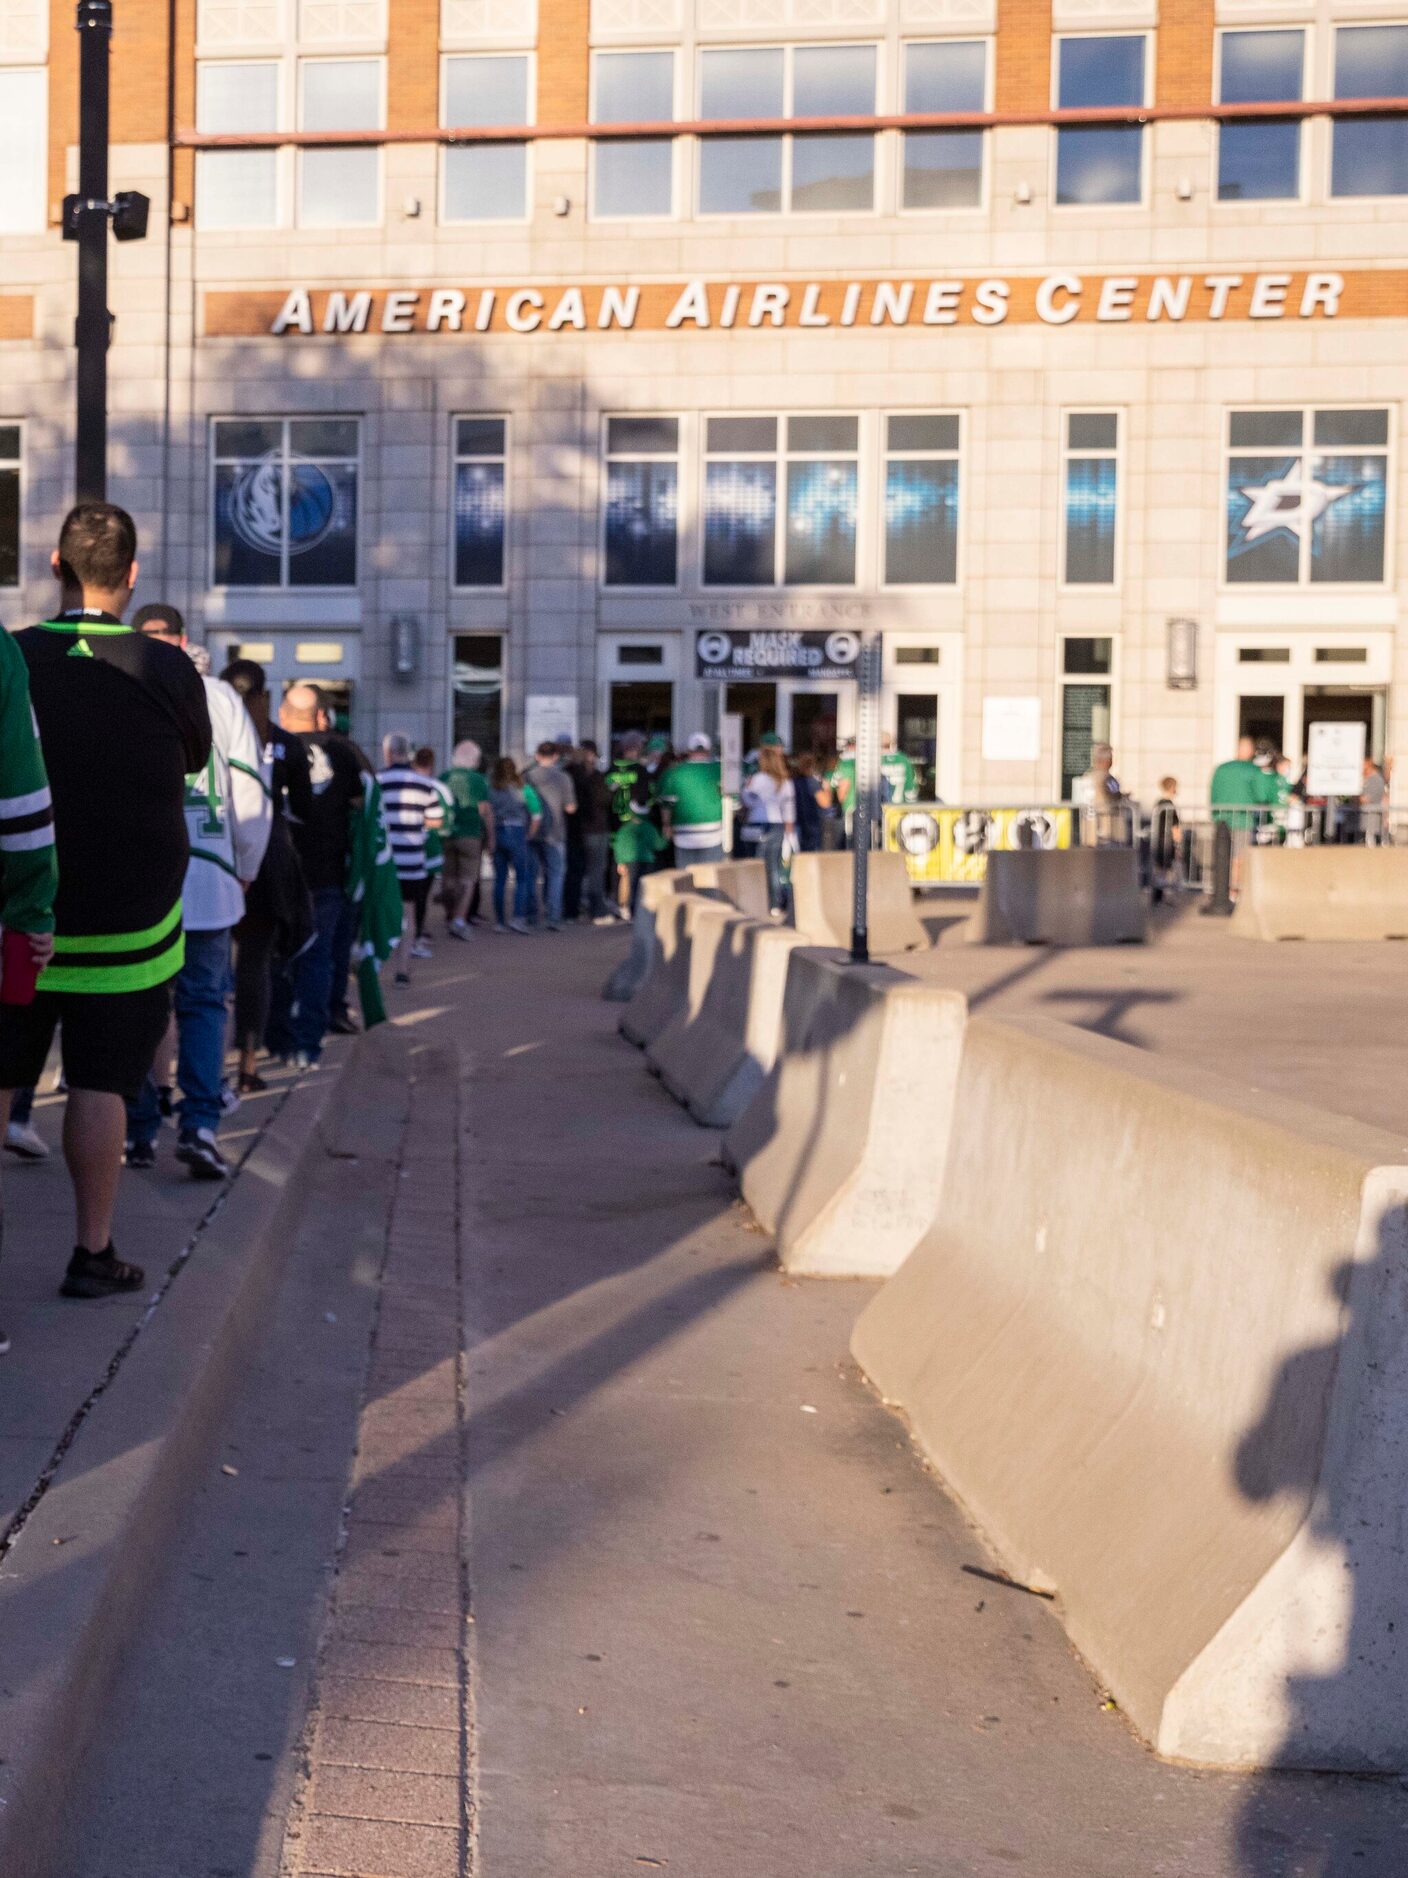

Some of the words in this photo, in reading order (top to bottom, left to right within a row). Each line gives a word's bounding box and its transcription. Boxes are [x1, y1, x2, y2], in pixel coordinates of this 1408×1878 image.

[271, 287, 641, 334] AMERICAN
[665, 279, 1010, 328] AIRLINES
[1034, 271, 1345, 325] CENTER
[749, 631, 804, 649] MASK
[732, 647, 824, 667] REQUIRED
